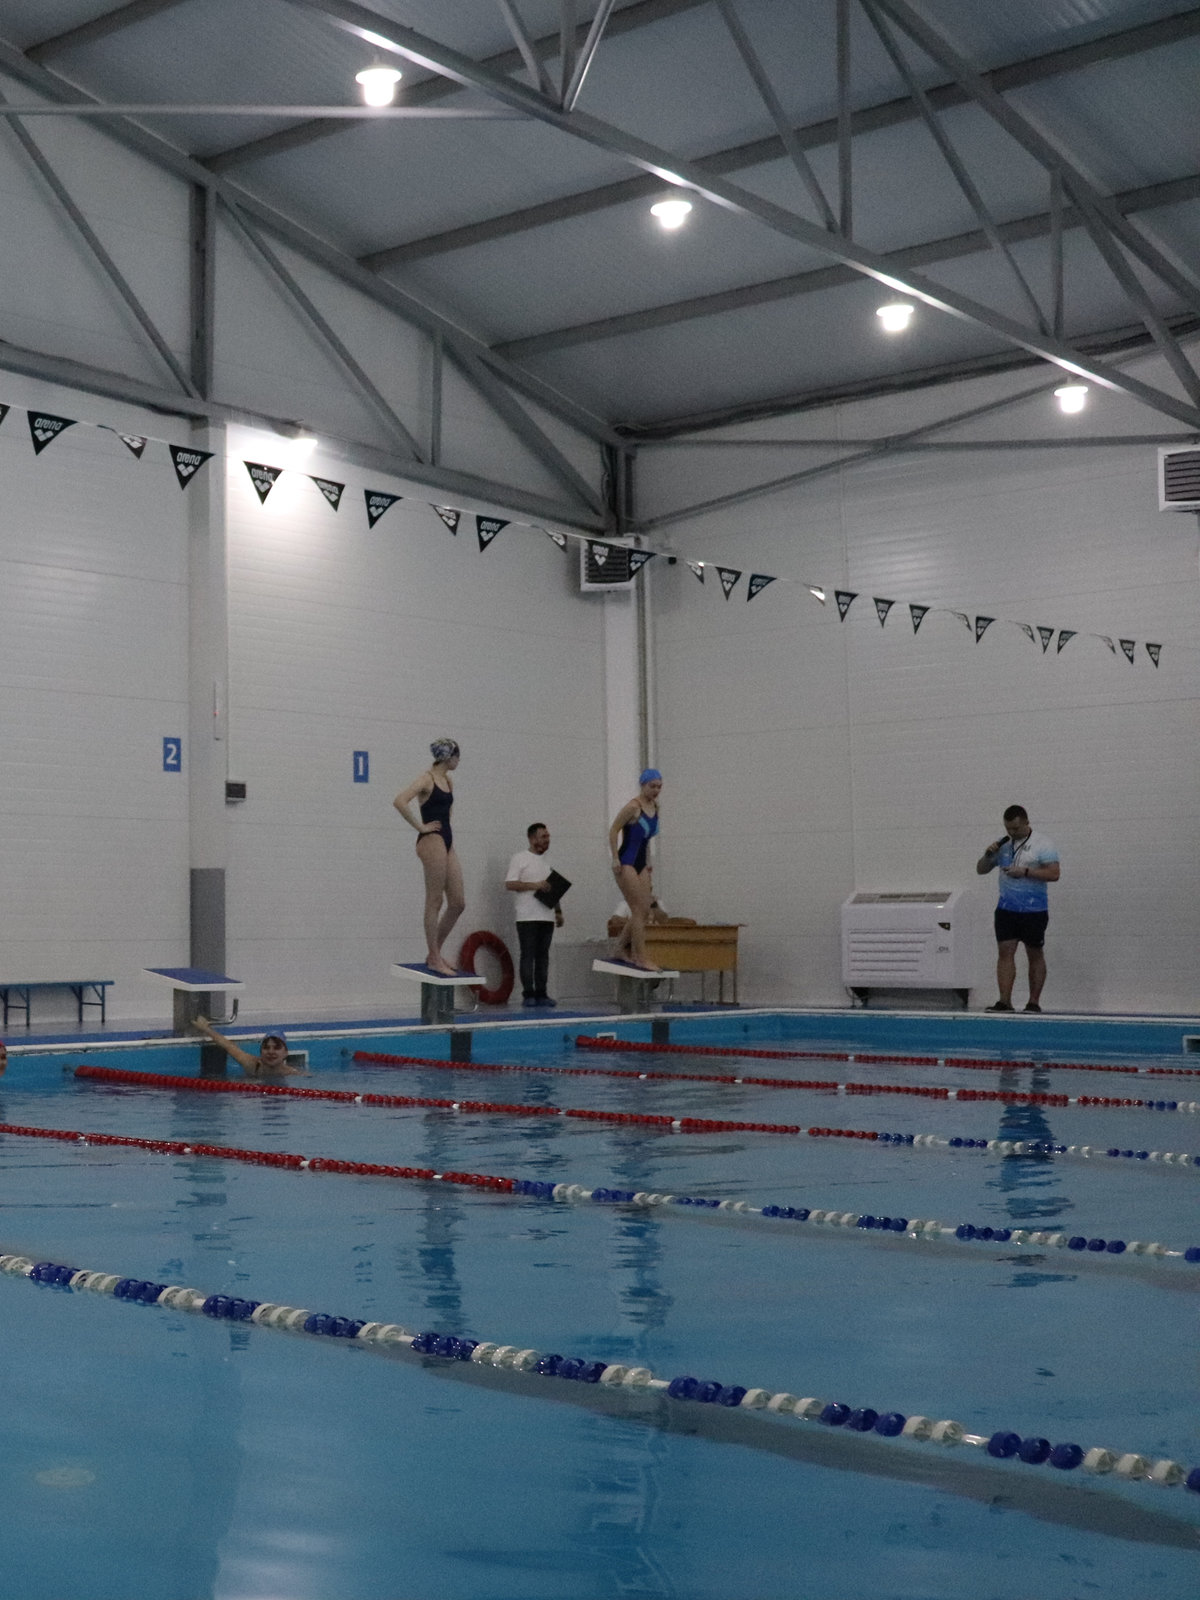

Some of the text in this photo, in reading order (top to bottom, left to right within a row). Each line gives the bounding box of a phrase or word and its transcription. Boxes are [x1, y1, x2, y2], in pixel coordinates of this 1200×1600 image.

[34, 418, 63, 431] arena
[176, 452, 201, 466] arena
[166, 744, 177, 764] 2
[357, 756, 363, 775] 1
